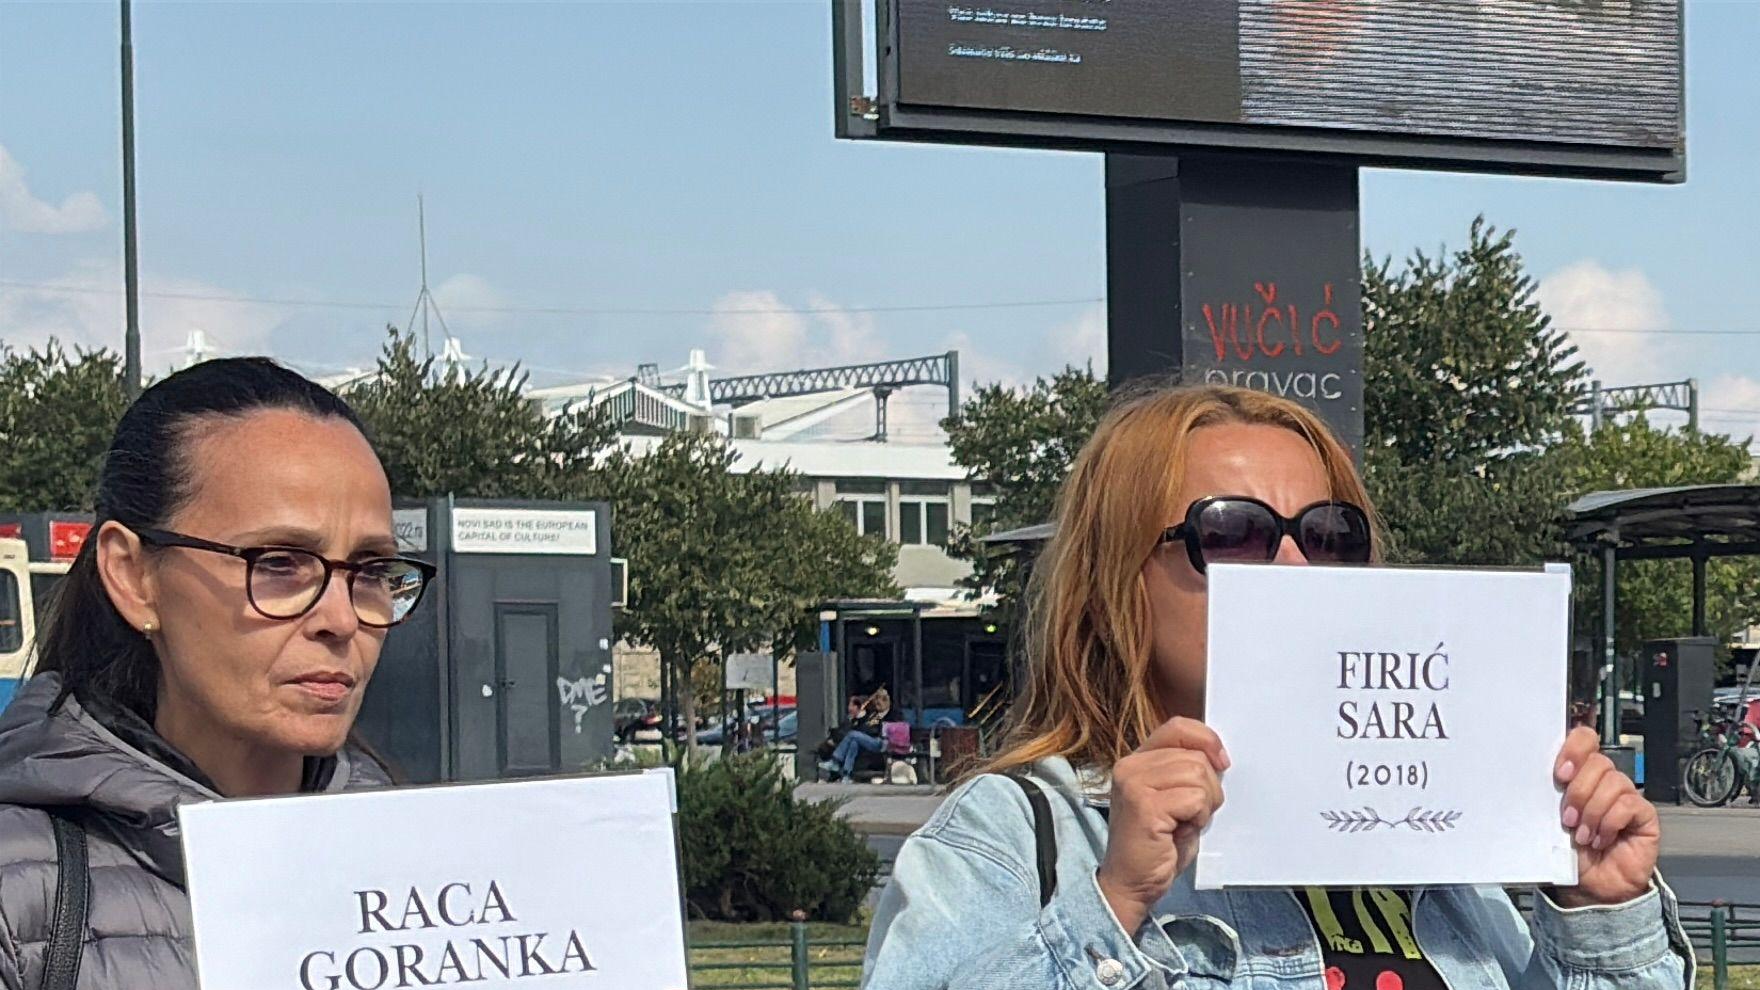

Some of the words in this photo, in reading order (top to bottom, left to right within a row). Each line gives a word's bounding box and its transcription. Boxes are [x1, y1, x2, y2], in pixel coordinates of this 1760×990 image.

[1202, 281, 1342, 362] VUČIĆ
[458, 532, 497, 541] CAPITAL
[500, 532, 511, 541] OF
[483, 520, 502, 530] SAD
[505, 520, 513, 529] IS
[517, 520, 535, 530] THE
[536, 521, 588, 531] EUROPEAN
[1336, 641, 1449, 691] FIRIĆ
[1336, 701, 1450, 740] SARA
[1346, 761, 1429, 790] (2018)
[353, 880, 517, 934] RACA
